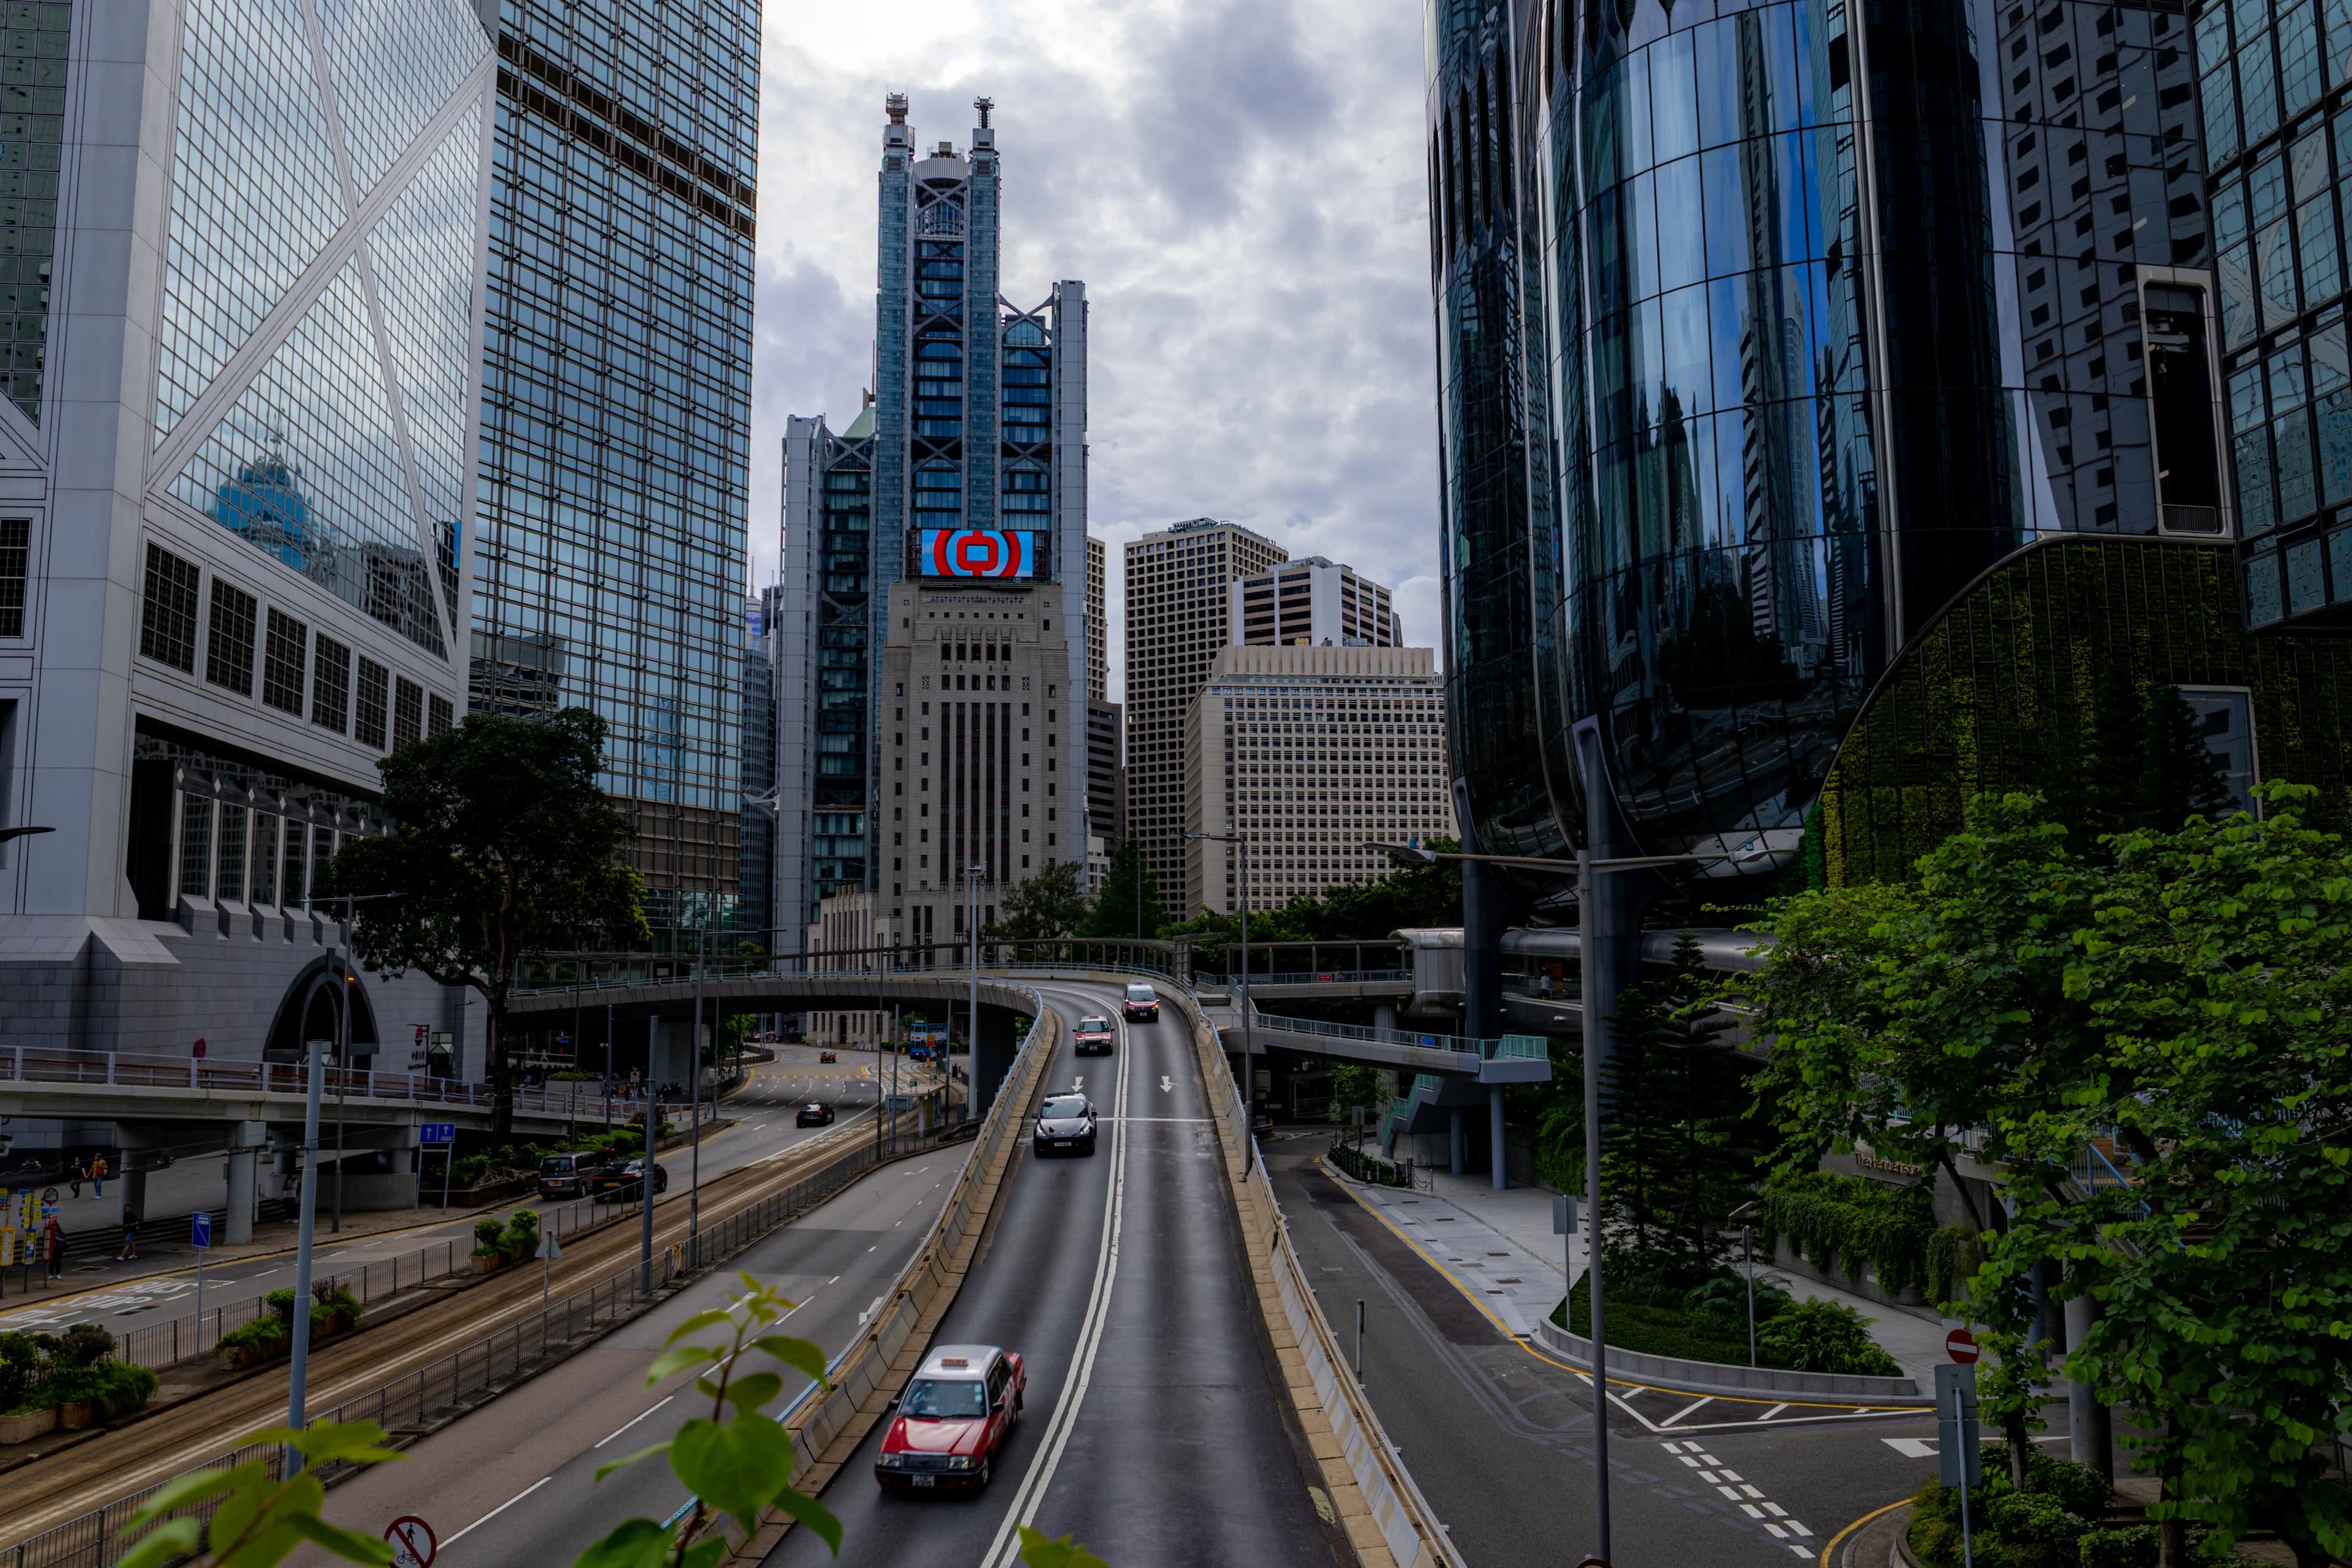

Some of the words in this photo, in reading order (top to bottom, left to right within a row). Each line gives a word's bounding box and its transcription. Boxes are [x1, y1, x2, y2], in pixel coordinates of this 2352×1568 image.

[1854, 1153, 1871, 1168] The
[111, 1281, 199, 1294] BUS
[50, 1295, 153, 1309] STOP
